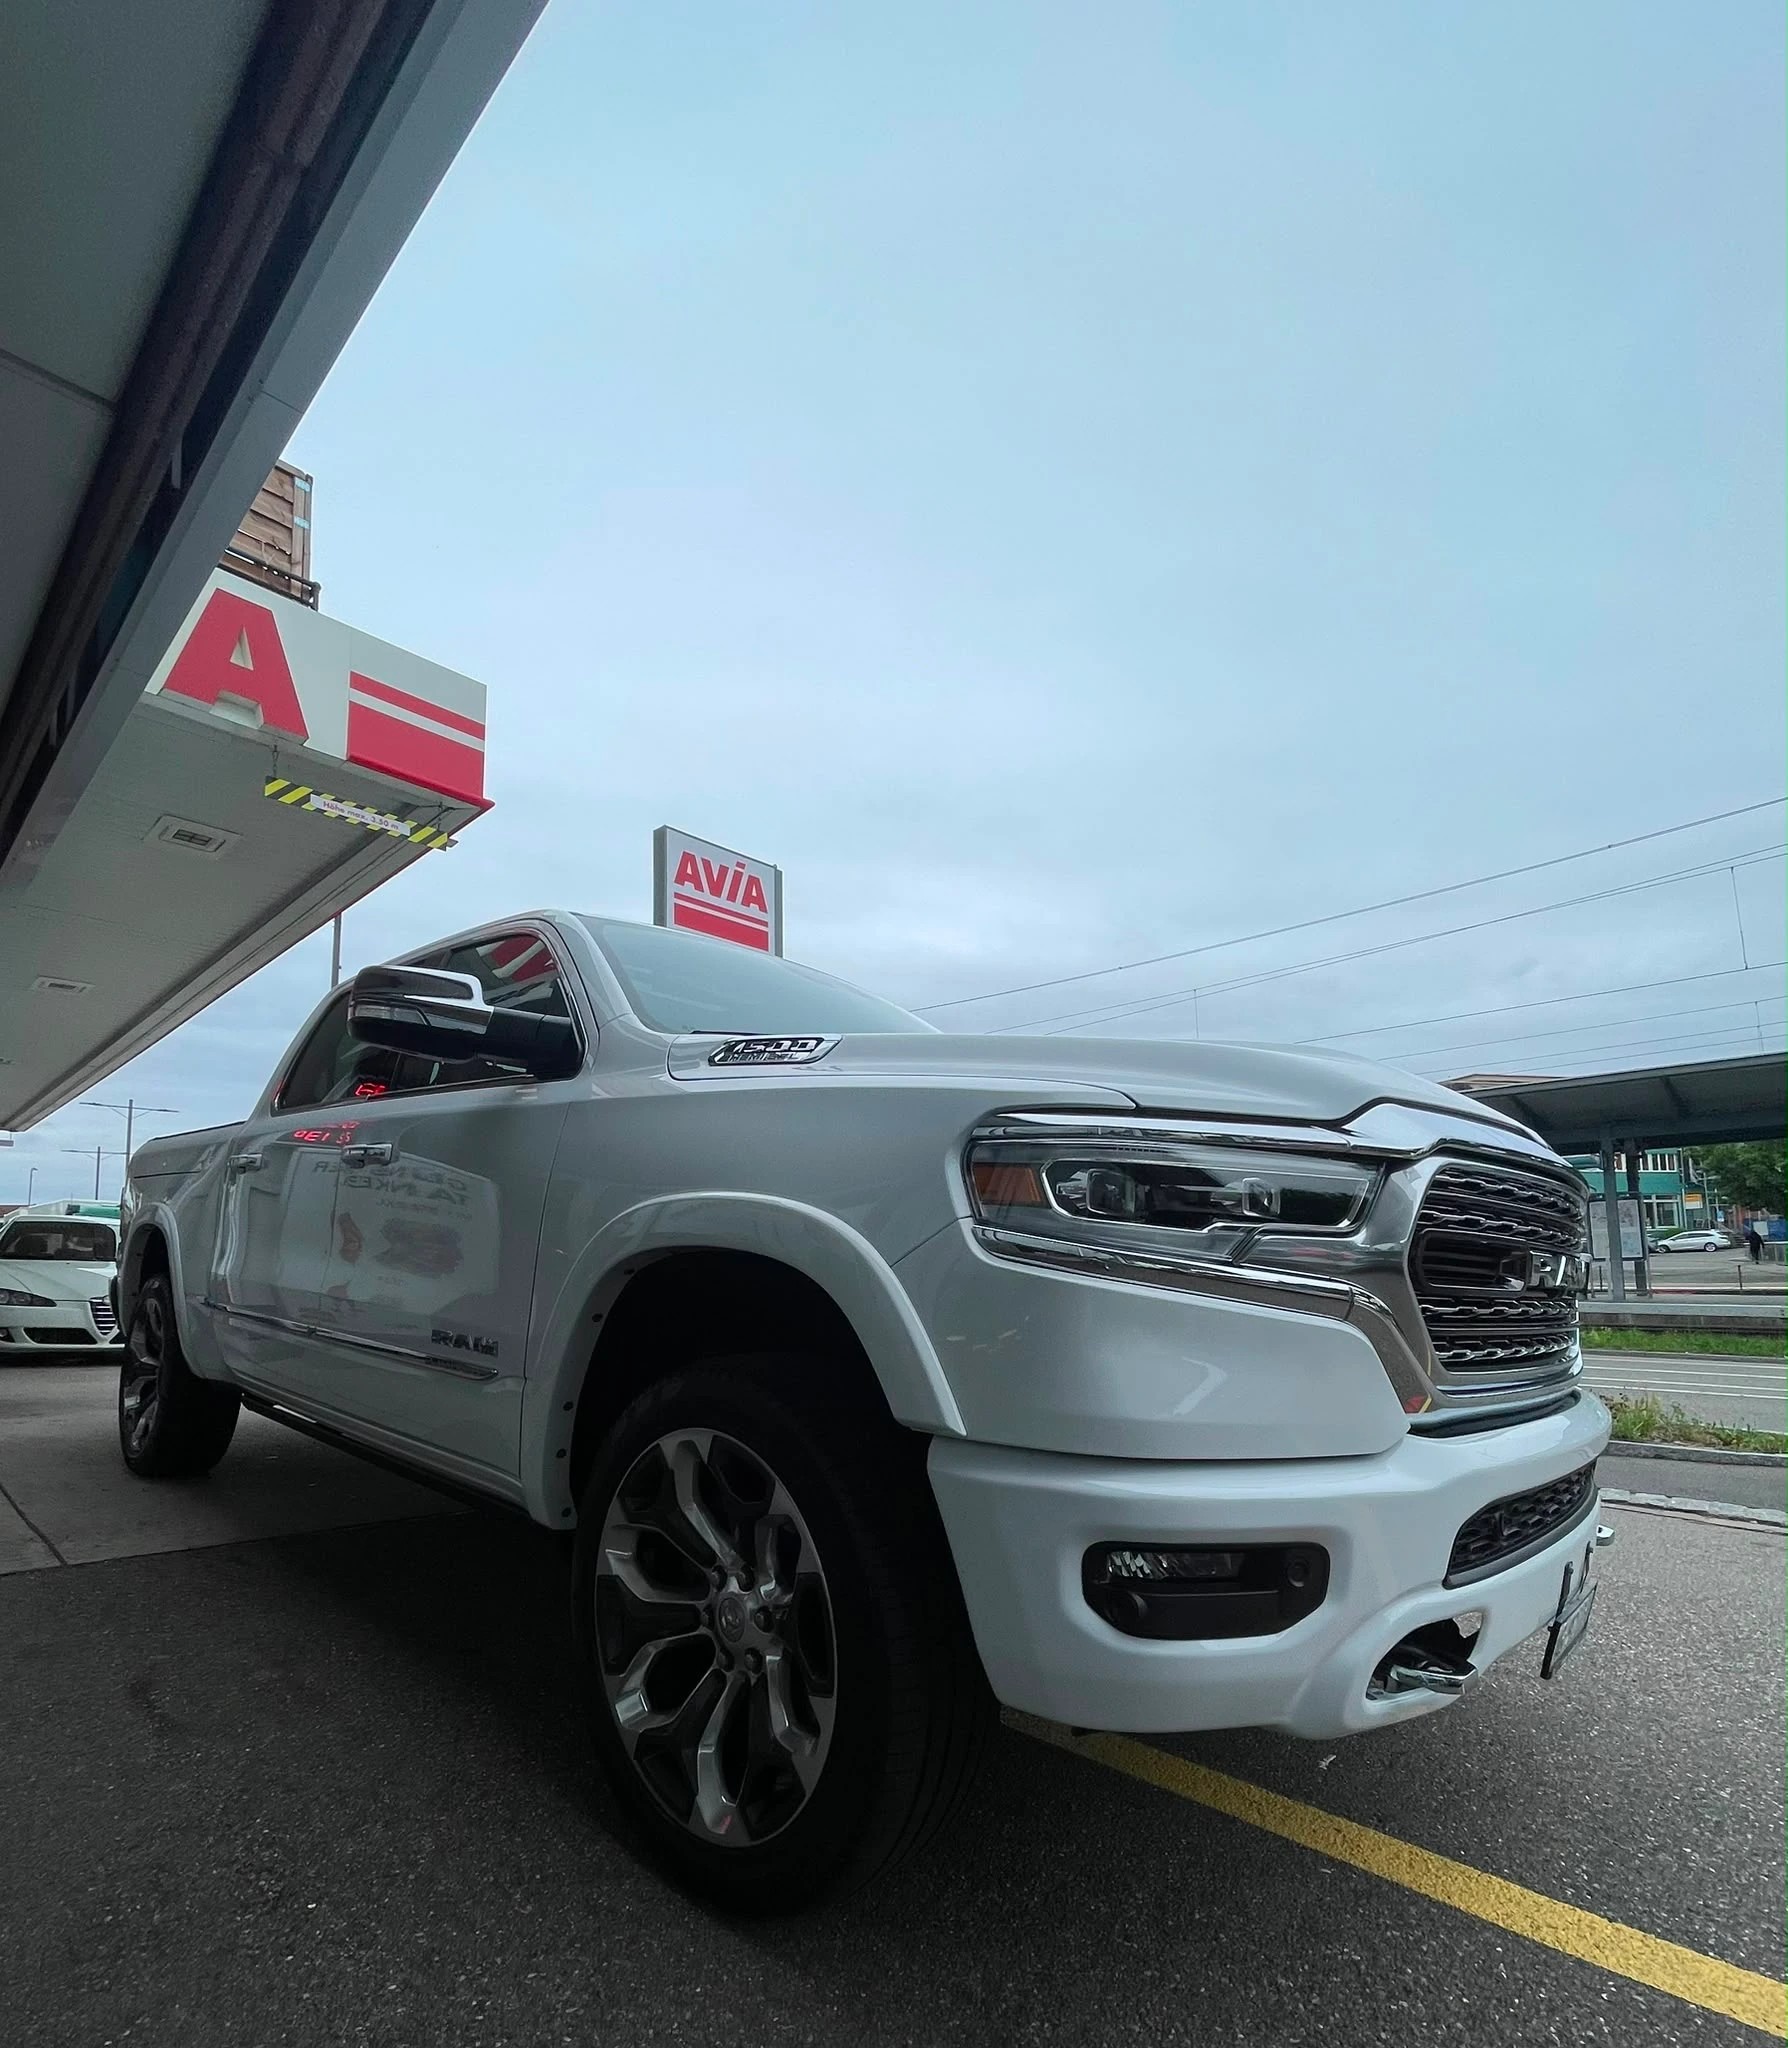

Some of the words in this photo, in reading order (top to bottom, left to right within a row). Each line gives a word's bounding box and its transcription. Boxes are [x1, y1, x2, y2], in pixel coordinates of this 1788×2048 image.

[163, 588, 309, 745] A
[323, 801, 345, 814] Höhe
[370, 816, 389, 827] 3.50
[674, 851, 768, 914] AVIA
[731, 1039, 819, 1053] 1500
[431, 1329, 498, 1357] RAM
